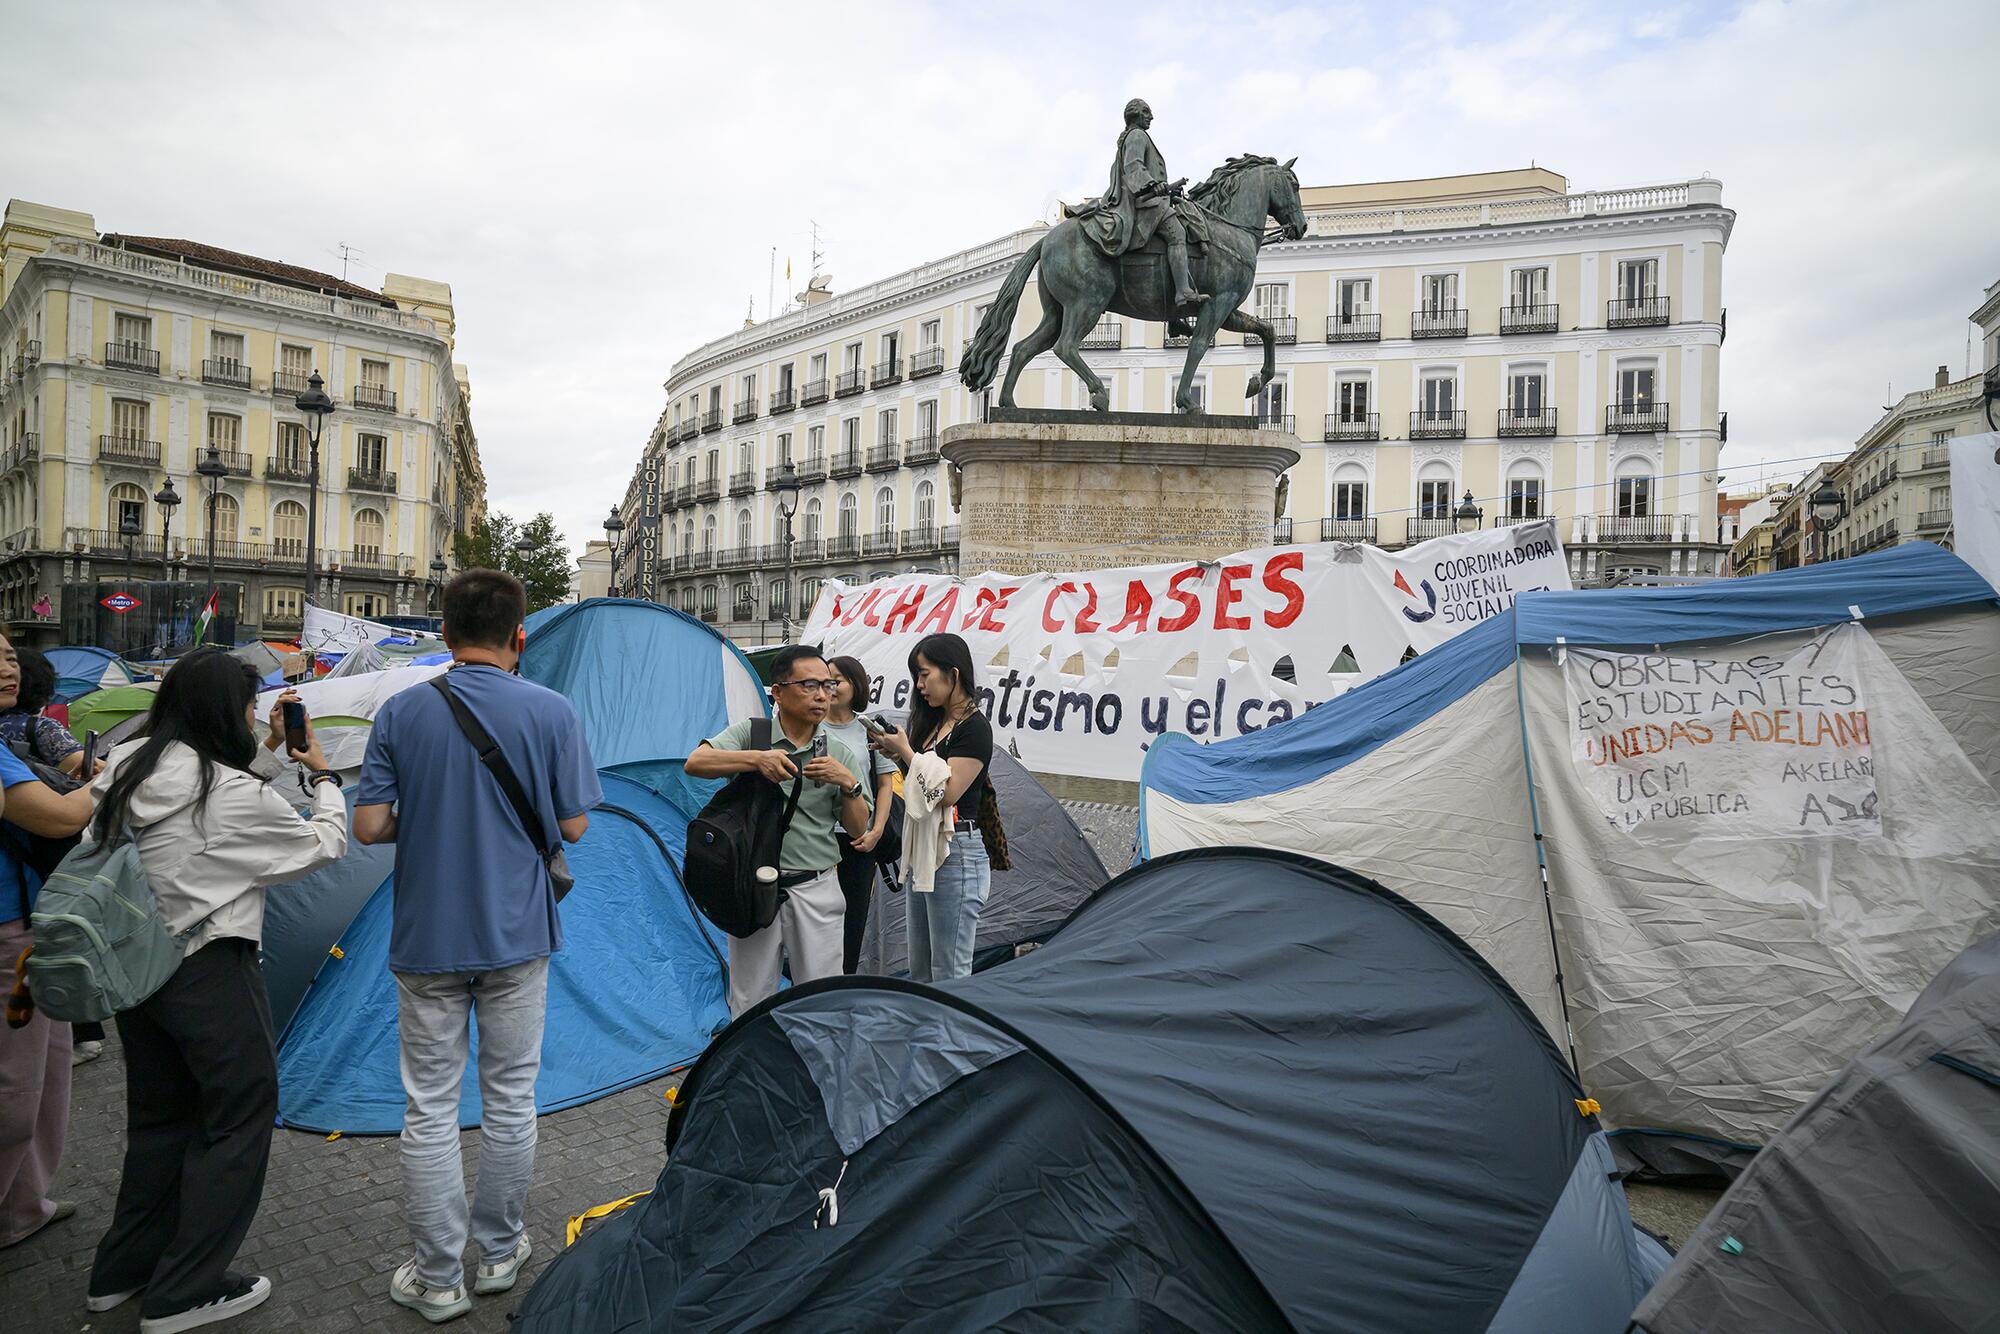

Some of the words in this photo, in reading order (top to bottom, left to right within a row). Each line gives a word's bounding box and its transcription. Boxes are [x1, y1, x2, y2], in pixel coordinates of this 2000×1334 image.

[644, 458, 656, 518] HOTEL
[1081, 560, 1146, 570] REFORMADO
[1434, 539, 1555, 582] COORDINADORA
[961, 587, 1021, 633] DE
[1041, 552, 1305, 634] CLASES
[1440, 574, 1512, 603] JUVENIL
[1443, 585, 1551, 623] SOCIAI
[1589, 655, 1785, 689] OBRERAS
[1801, 631, 1834, 669] Y
[975, 669, 1123, 736] ntismo
[1140, 696, 1169, 752] y
[1185, 677, 1227, 737] el
[1236, 698, 1325, 736] ca
[1578, 675, 1857, 731] ESTUDIANTES
[1586, 718, 1714, 766] UNIDAS
[1616, 761, 1689, 804] UCM
[1625, 809, 1646, 825] LA
